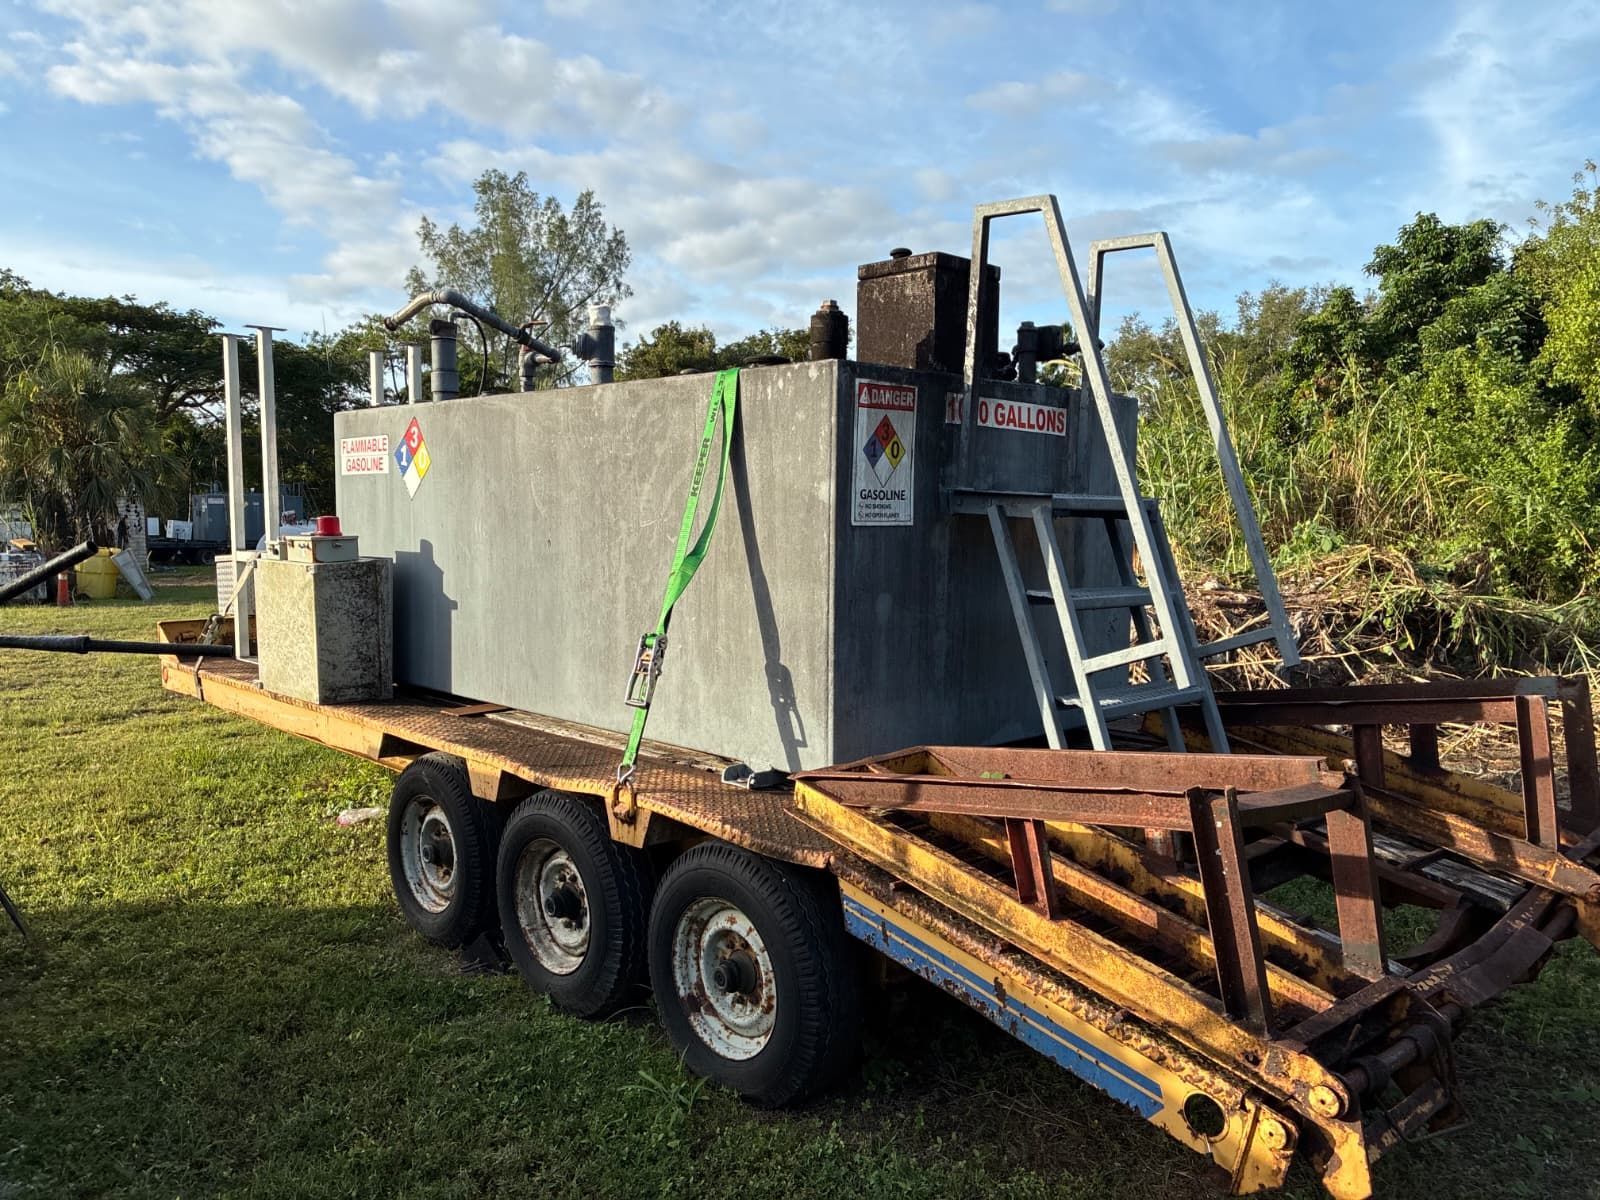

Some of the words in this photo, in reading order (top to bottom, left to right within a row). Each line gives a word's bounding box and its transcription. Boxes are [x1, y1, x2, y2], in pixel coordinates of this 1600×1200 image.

[871, 388, 914, 407] DANGER
[994, 402, 1065, 434] GALLONS
[410, 426, 419, 449] 3
[881, 421, 890, 439] 3
[342, 437, 388, 455] FLAMMABLE
[400, 444, 408, 467] 1
[419, 451, 427, 467] 0
[870, 439, 878, 458] 1
[891, 440, 900, 459] 0
[345, 457, 384, 472] GASOLINE
[690, 437, 711, 497] KEEPER
[860, 489, 906, 501] GASOLINE
